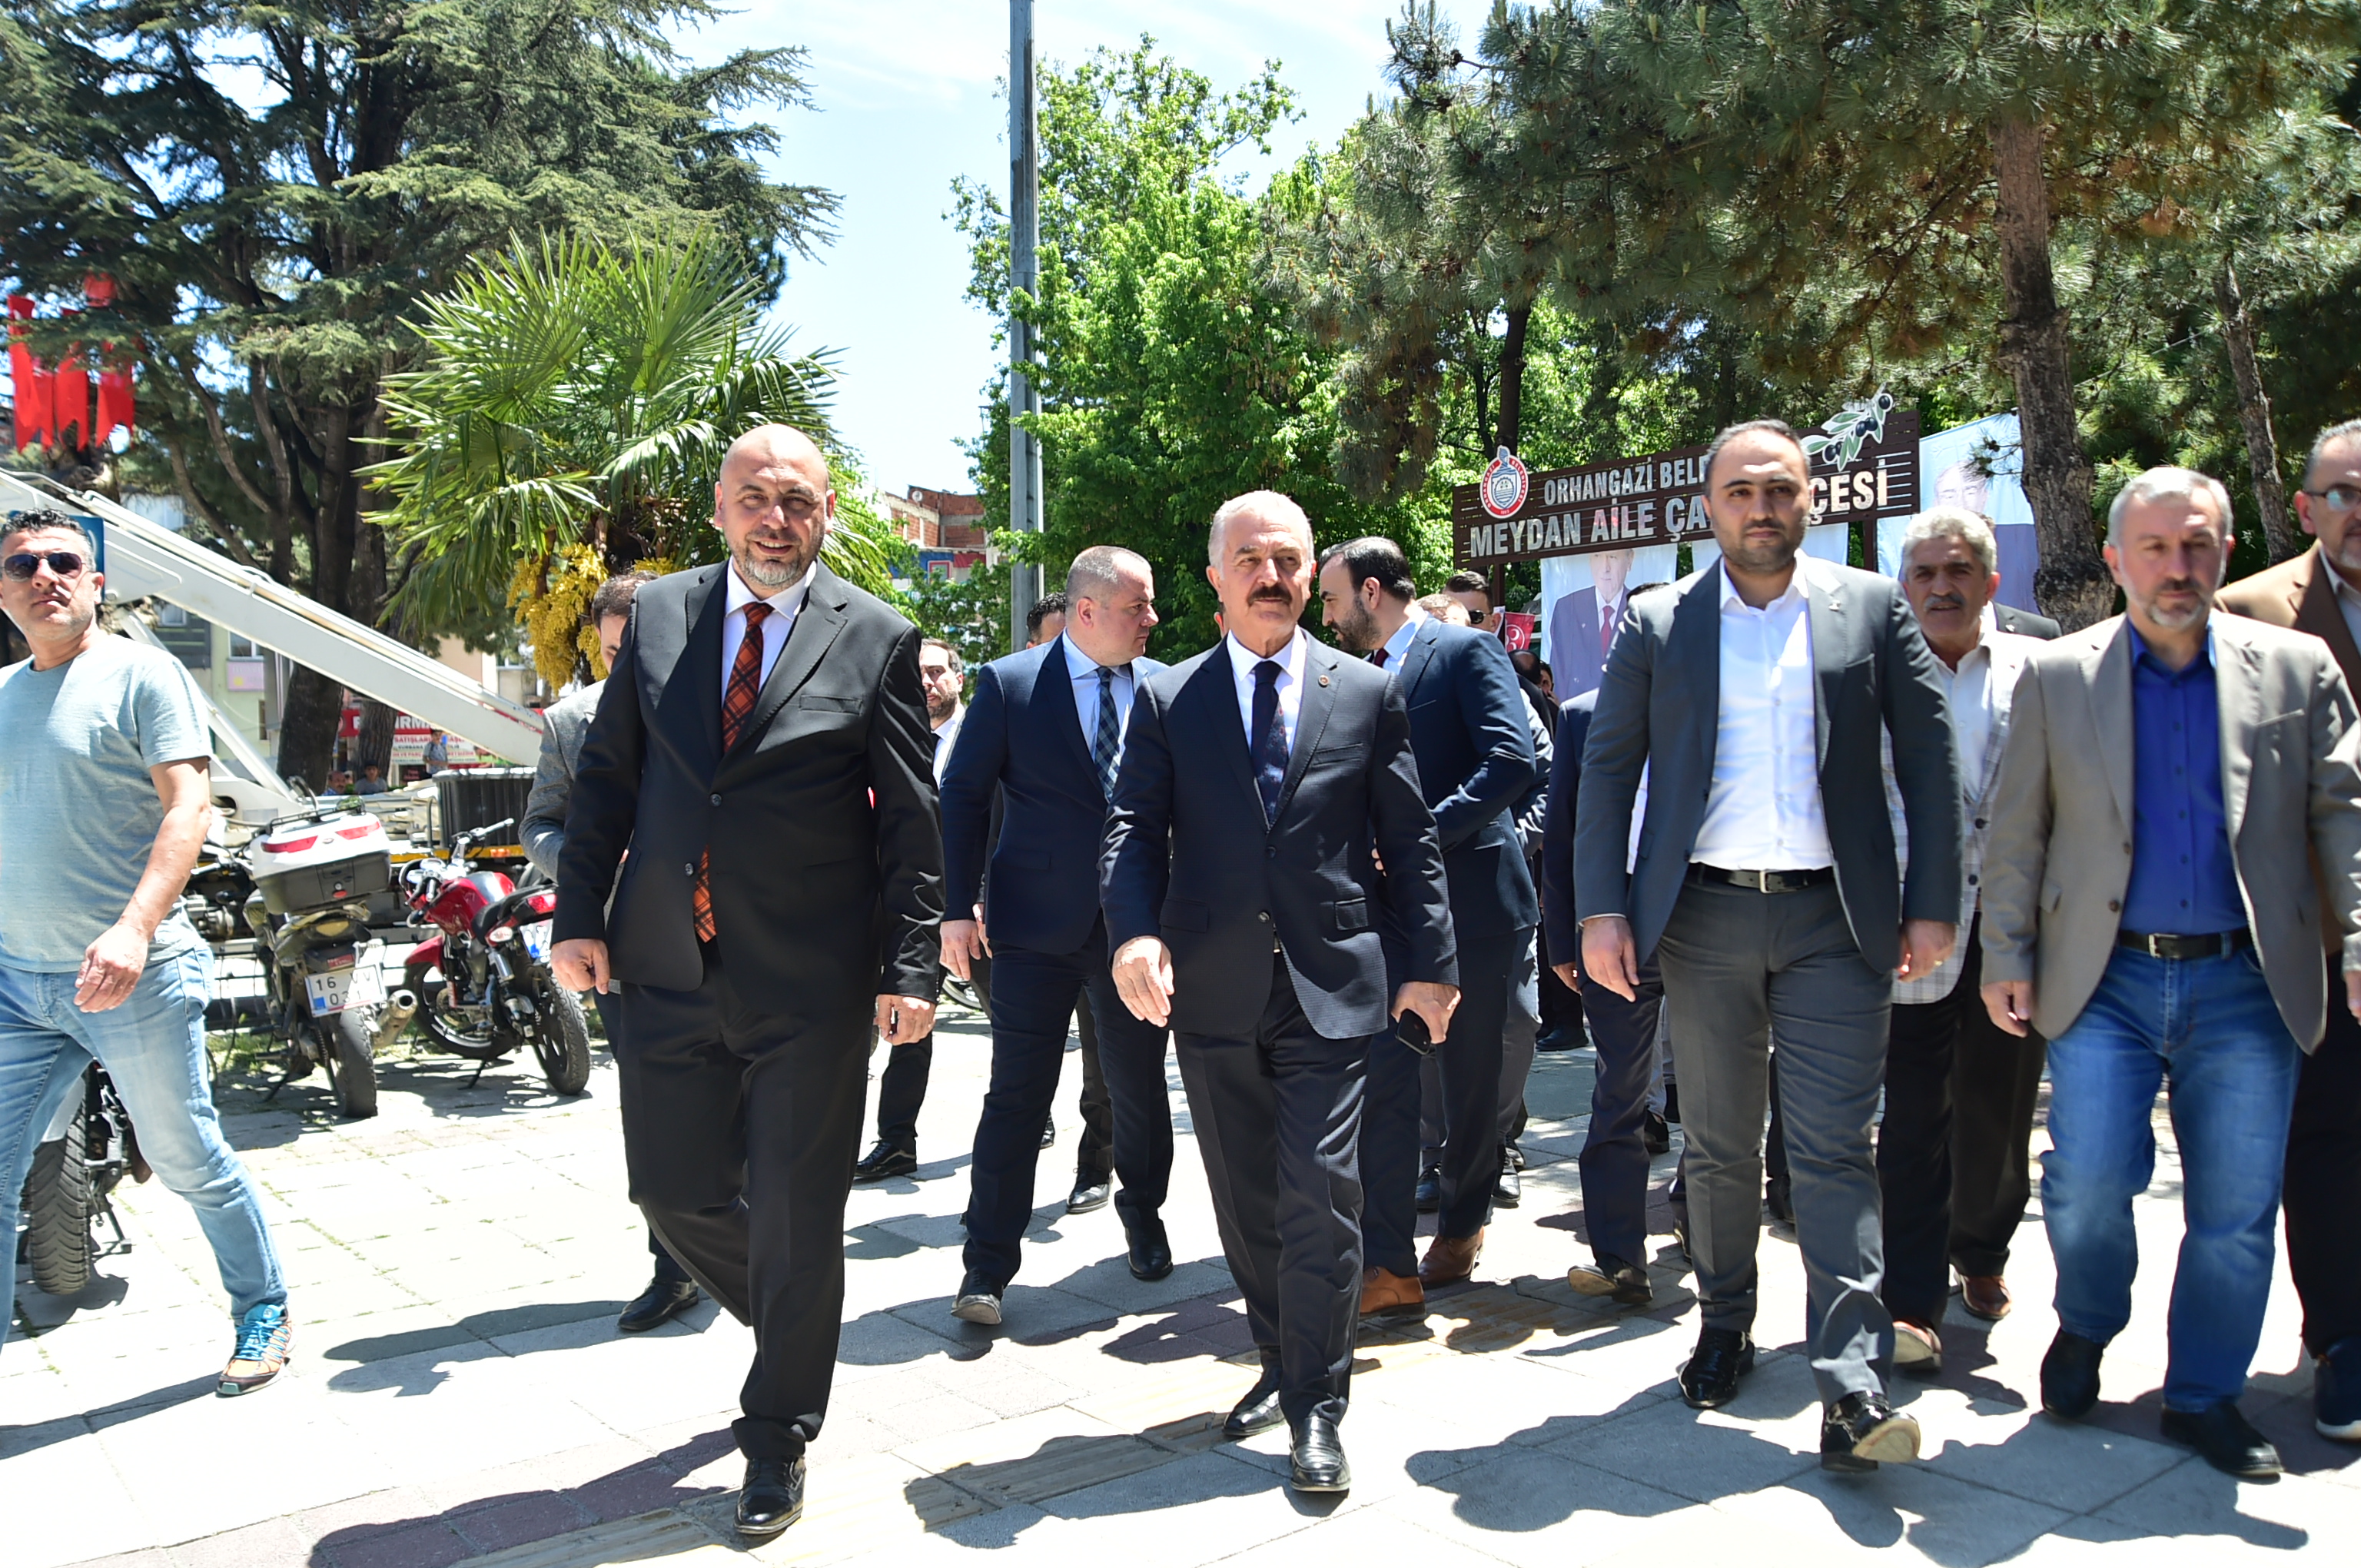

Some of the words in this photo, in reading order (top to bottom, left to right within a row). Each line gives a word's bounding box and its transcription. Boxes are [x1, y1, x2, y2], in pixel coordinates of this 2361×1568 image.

[1544, 457, 1653, 506] ORHANGAZİ
[1470, 512, 1581, 558] MEYDAN
[1590, 498, 1653, 543] AİLE
[1665, 495, 1712, 542] ÇA
[1808, 459, 1888, 525] ÇESİ
[316, 976, 337, 992] 16
